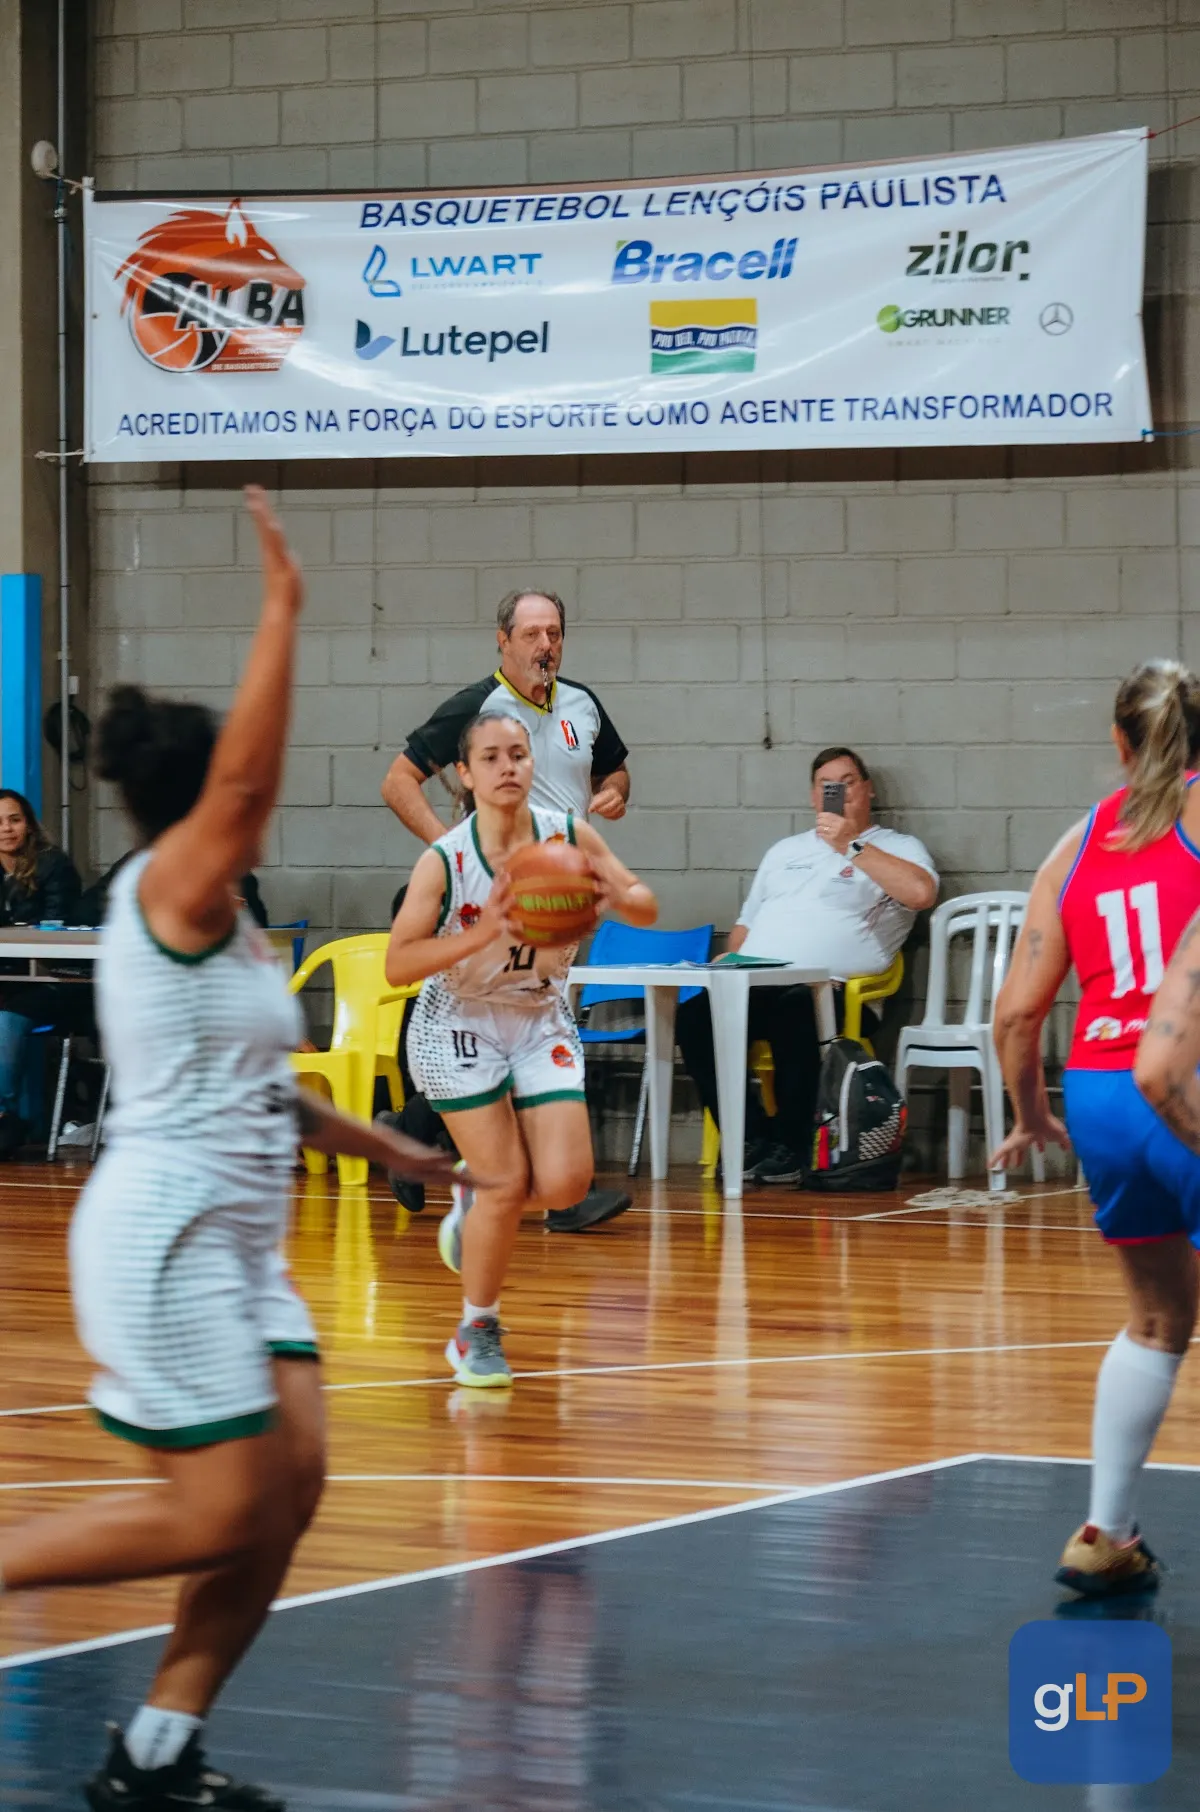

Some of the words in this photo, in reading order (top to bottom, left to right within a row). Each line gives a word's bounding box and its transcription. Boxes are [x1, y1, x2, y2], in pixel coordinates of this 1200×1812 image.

[360, 194, 629, 229] BASQUETEBOL
[643, 182, 806, 221] LENÇÓIS
[820, 174, 1007, 211] PAULISTA
[411, 253, 543, 278] LWART
[611, 237, 799, 284] Bracell
[901, 307, 1011, 328] GRUNNER
[401, 320, 550, 363] Lutepel
[117, 410, 297, 436] ACREDITAMOS
[305, 409, 340, 433] NA
[349, 407, 437, 437] FORÇA
[449, 405, 486, 430] DO
[495, 403, 618, 429] ESPORTE
[626, 401, 711, 427] COMO
[720, 398, 835, 425] AGENTE
[844, 392, 1114, 421] TRANSFORMADOR
[1096, 880, 1165, 999] 11
[452, 1029, 478, 1058] 10
